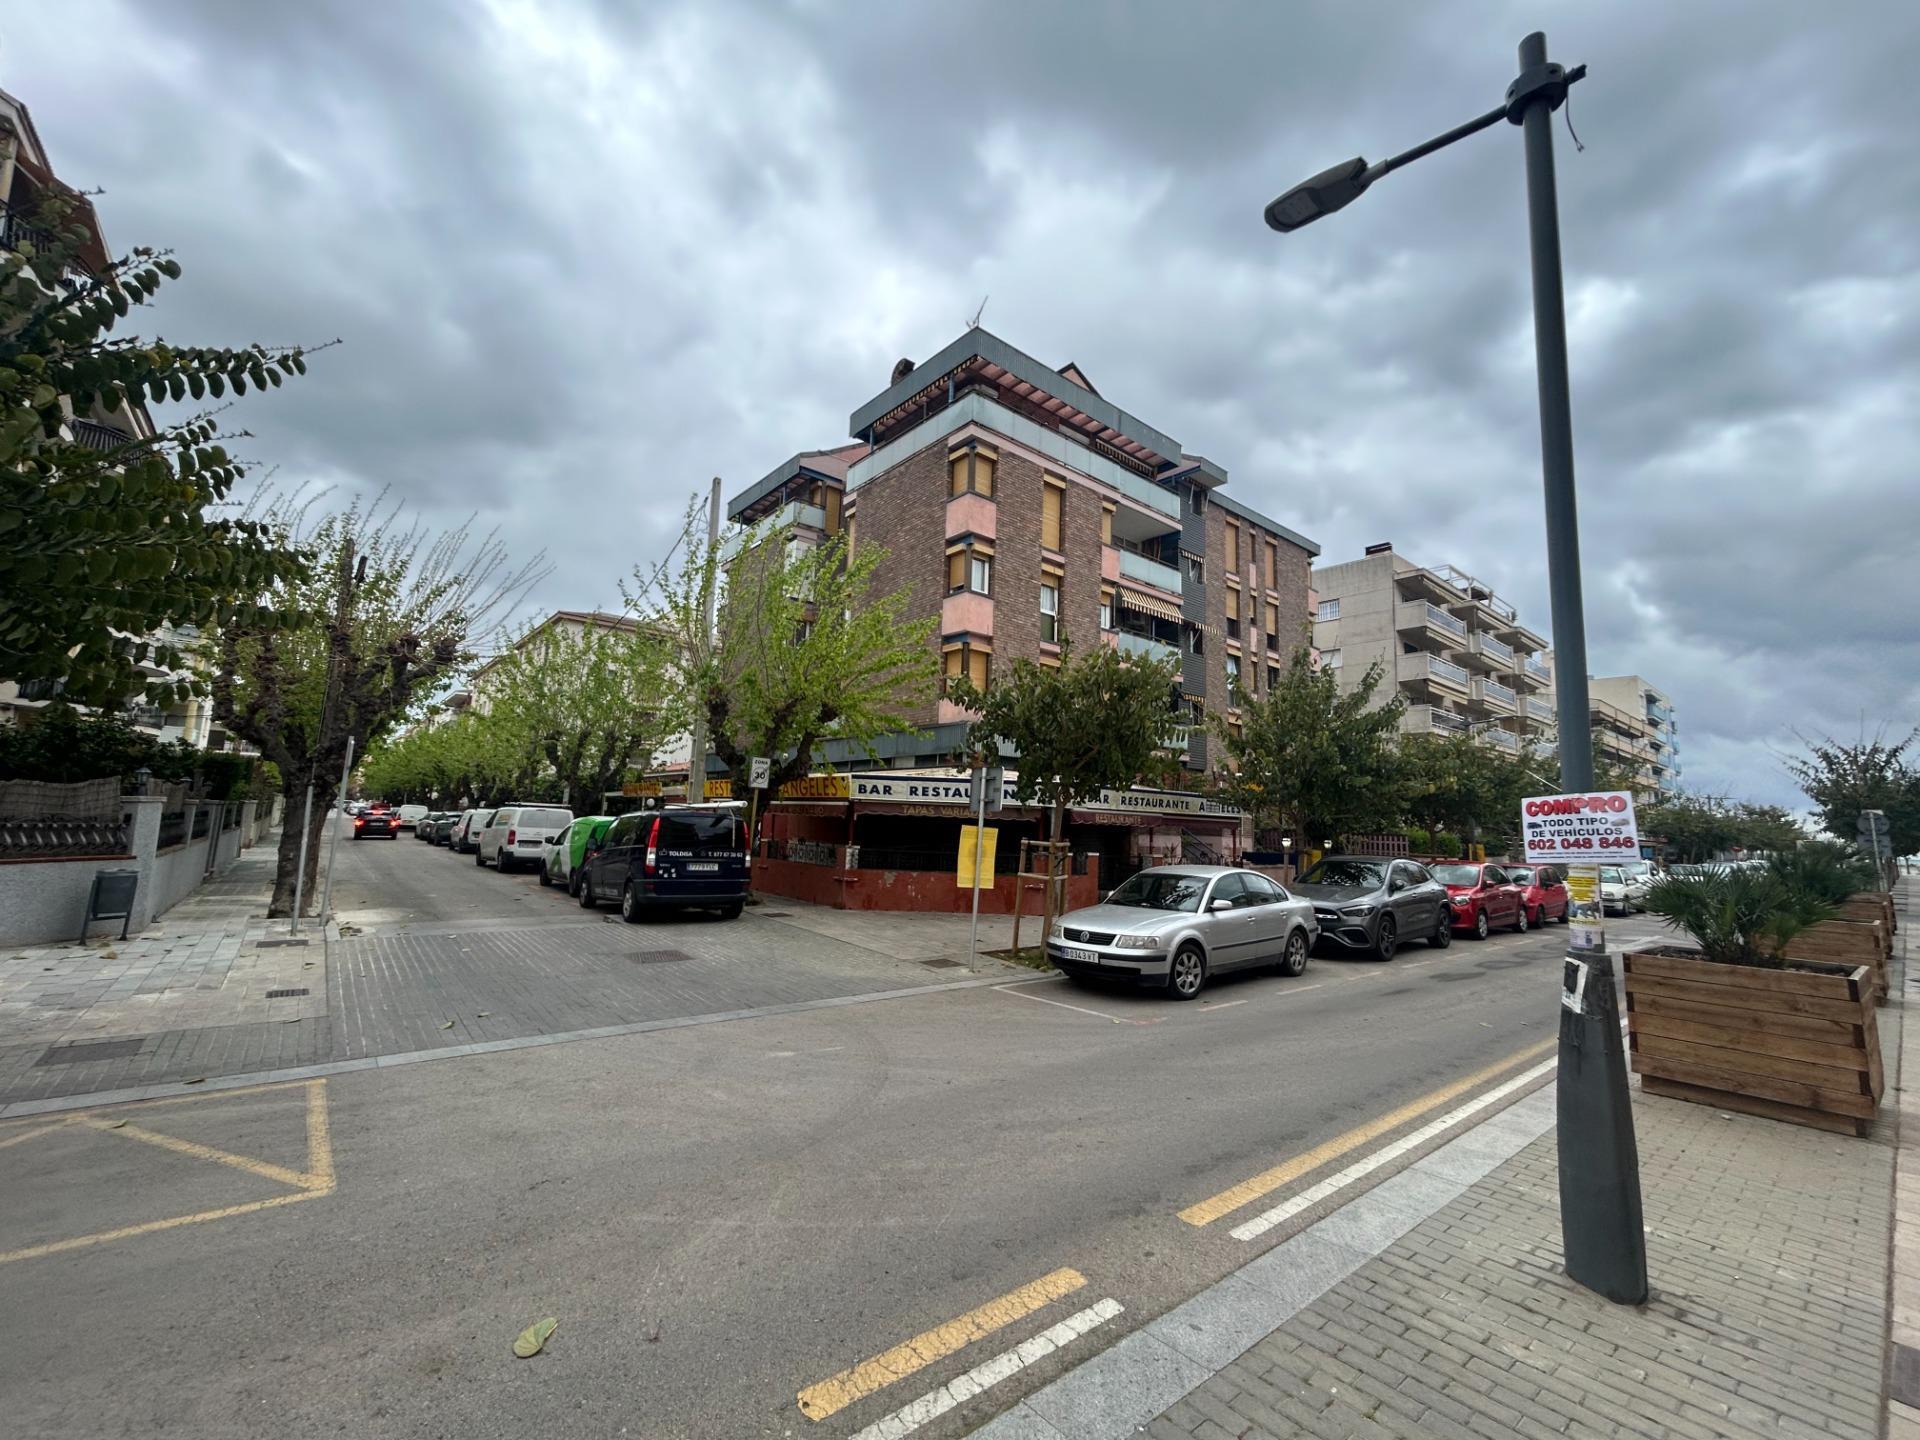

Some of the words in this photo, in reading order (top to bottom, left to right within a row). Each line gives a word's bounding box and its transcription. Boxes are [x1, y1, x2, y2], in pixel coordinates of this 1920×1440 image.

[754, 771, 766, 780] 30
[783, 777, 838, 797] ANGELES
[858, 784, 893, 796] BAR
[909, 786, 1017, 801] RESTAUN
[903, 804, 935, 816] TAPAS
[1120, 796, 1190, 811] RESTAURANTE
[1199, 801, 1241, 814] AELES
[1526, 795, 1628, 817] COMPRO
[1095, 814, 1142, 825] RESTAURANTE
[1542, 819, 1574, 828] TODO
[1577, 817, 1609, 826] TIPO
[1532, 830, 1546, 838] DE
[1549, 827, 1623, 838] VEHÍCULOS
[1527, 839, 1556, 850] 602
[1560, 838, 1594, 850] 048
[1599, 836, 1636, 849] 846
